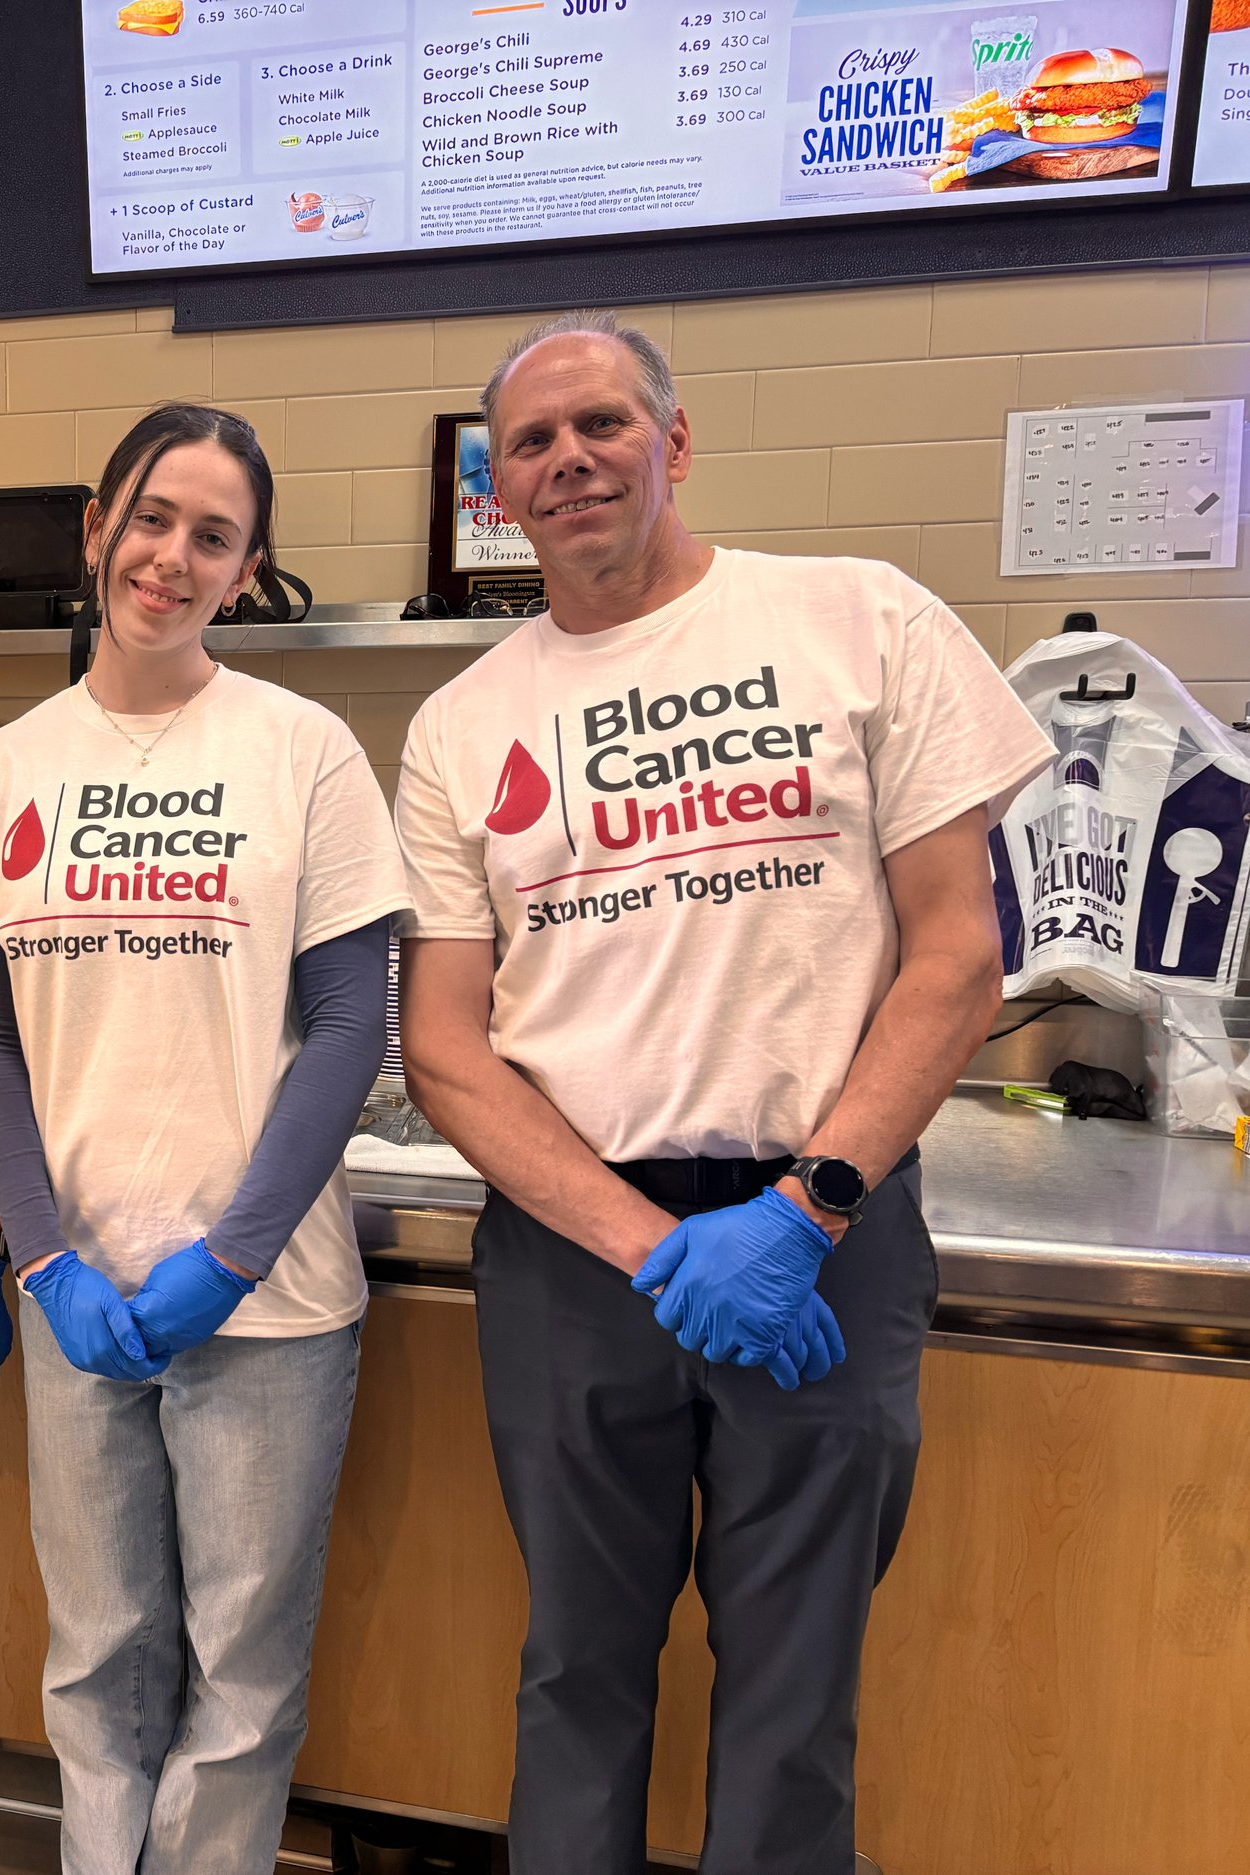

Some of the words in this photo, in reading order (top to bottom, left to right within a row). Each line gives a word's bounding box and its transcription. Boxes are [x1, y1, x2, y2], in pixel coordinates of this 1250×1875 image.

[198, 11, 225, 23] 6.59
[234, 4, 287, 19] 360-740
[290, 3, 304, 13] Cal
[681, 14, 712, 28] 4.29
[722, 10, 746, 24] 310
[750, 10, 766, 21] Cal
[423, 37, 491, 58] George's
[496, 32, 530, 48] Chili
[679, 39, 711, 52] 4.69
[721, 35, 749, 49] 430
[752, 35, 769, 46] Cal
[262, 67, 274, 80] 3.
[279, 60, 333, 78] Choose
[339, 61, 347, 71] a
[352, 54, 392, 69] Drink
[423, 62, 491, 82] George's
[496, 58, 529, 73] Chili
[534, 51, 603, 70] Supreme
[679, 64, 709, 78] 3.69
[719, 60, 746, 74] 250
[750, 60, 767, 71] Cal
[838, 48, 920, 80] Crispy
[105, 85, 116, 97] 2.
[121, 78, 173, 95] Choose
[178, 79, 186, 89] a
[191, 73, 222, 88] Side
[423, 87, 484, 105] Broccoli
[489, 81, 544, 98] Cheese
[549, 77, 589, 94] Soup
[678, 89, 708, 102] 3.69
[718, 85, 741, 98] 130
[745, 85, 762, 96] Cal
[279, 92, 315, 105] White
[319, 89, 344, 102] Milk
[819, 76, 932, 122] CHICKEN
[122, 108, 153, 121] Small
[158, 105, 186, 118] Fries
[279, 109, 341, 126] Chocolate
[346, 107, 371, 119] Milk
[422, 111, 482, 129] Chicken
[487, 105, 542, 122] Noodle
[547, 102, 587, 119] Soup
[676, 114, 706, 127] 3.69
[716, 109, 745, 123] 300
[748, 110, 766, 121] Cal
[148, 123, 217, 140] Applesauce
[306, 130, 343, 145] Apple
[347, 127, 380, 141] Juice
[422, 137, 456, 152] Wild
[461, 133, 488, 148] and
[494, 130, 542, 146] Brown
[548, 125, 579, 140] Rice
[585, 121, 618, 137] with
[801, 117, 944, 165] SANDWICH
[123, 146, 175, 161] Steamed
[179, 142, 227, 157] Broccoli
[422, 151, 481, 168] Chicken
[486, 149, 524, 166] Soup
[123, 168, 154, 177] Additional
[155, 167, 180, 176] charges
[181, 166, 194, 174] may
[196, 164, 212, 173] apply
[523, 170, 548, 178] general
[550, 165, 579, 175] nutrition
[621, 160, 644, 168] calorie
[647, 158, 667, 166] needs
[669, 156, 684, 164] may
[799, 164, 860, 177] VALUE
[864, 158, 941, 171] BASKET
[421, 187, 455, 195] Additional
[457, 184, 485, 192] nutrition
[486, 180, 525, 189] information
[527, 177, 556, 186] available
[122, 206, 127, 217] 1
[132, 201, 176, 217] Scoop
[180, 199, 194, 212] of
[199, 195, 253, 210] Custard
[434, 204, 450, 212] serve
[453, 201, 482, 210] products
[331, 210, 365, 228] Culver's
[122, 229, 165, 242] Vanilla,
[169, 224, 229, 238] Chocolate
[233, 223, 246, 233] or
[122, 242, 159, 255] Flavor
[164, 240, 175, 252] of
[178, 238, 198, 251] the
[202, 237, 225, 251] Day
[583, 665, 779, 747] Blood
[585, 723, 823, 792] Cancer
[77, 782, 224, 819] Blood
[592, 766, 811, 850] United
[70, 825, 248, 859] Cancer
[65, 861, 228, 903] United
[665, 857, 825, 904] Together
[1033, 851, 1128, 906] DELICIOUS
[1048, 896, 1075, 910] IN
[1080, 897, 1108, 916] THE
[6, 934, 109, 961] Stronger
[114, 929, 233, 960] Together
[1031, 913, 1124, 955] BAG
